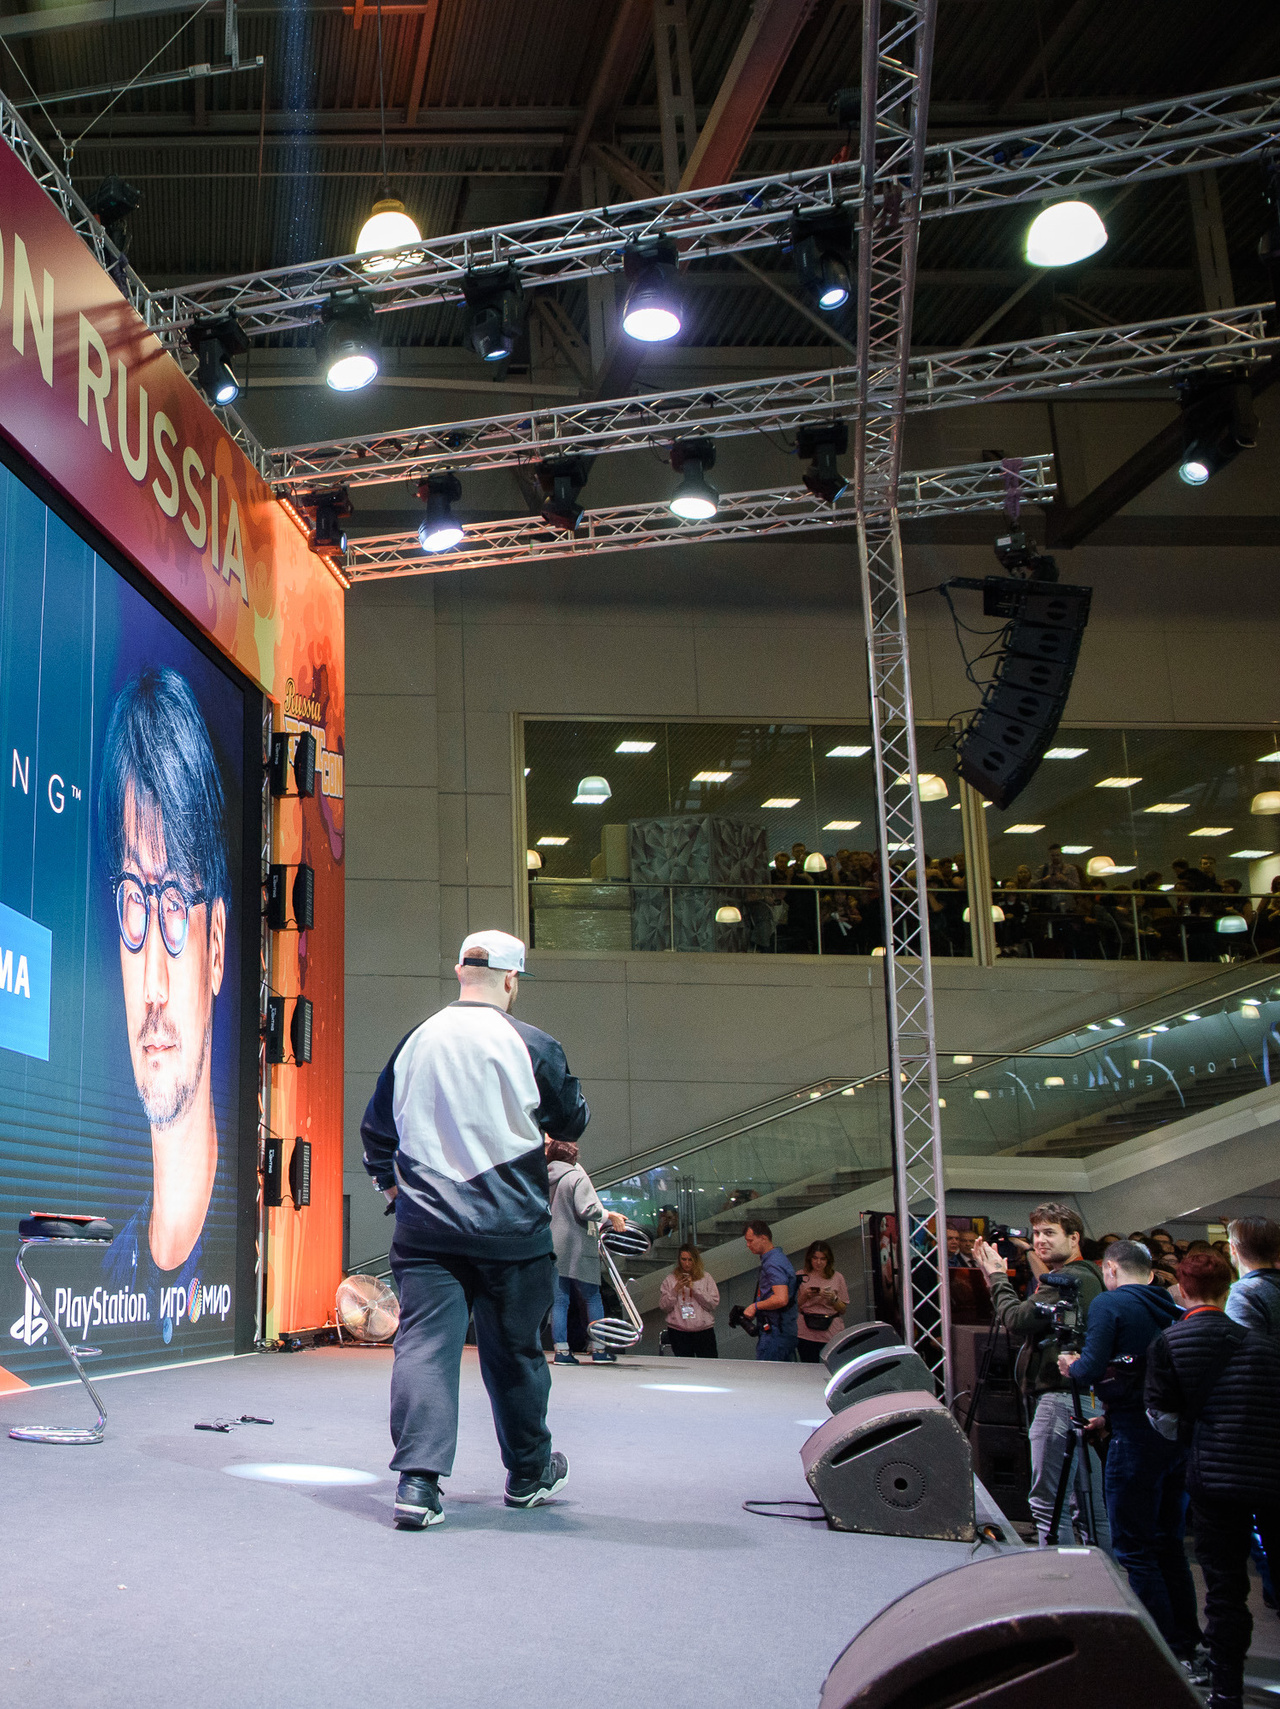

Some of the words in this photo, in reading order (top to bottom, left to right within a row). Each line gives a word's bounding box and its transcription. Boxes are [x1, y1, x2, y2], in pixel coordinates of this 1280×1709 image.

[79, 312, 248, 604] RUSSIA
[284, 678, 322, 722] Russia
[321, 750, 344, 798] CON
